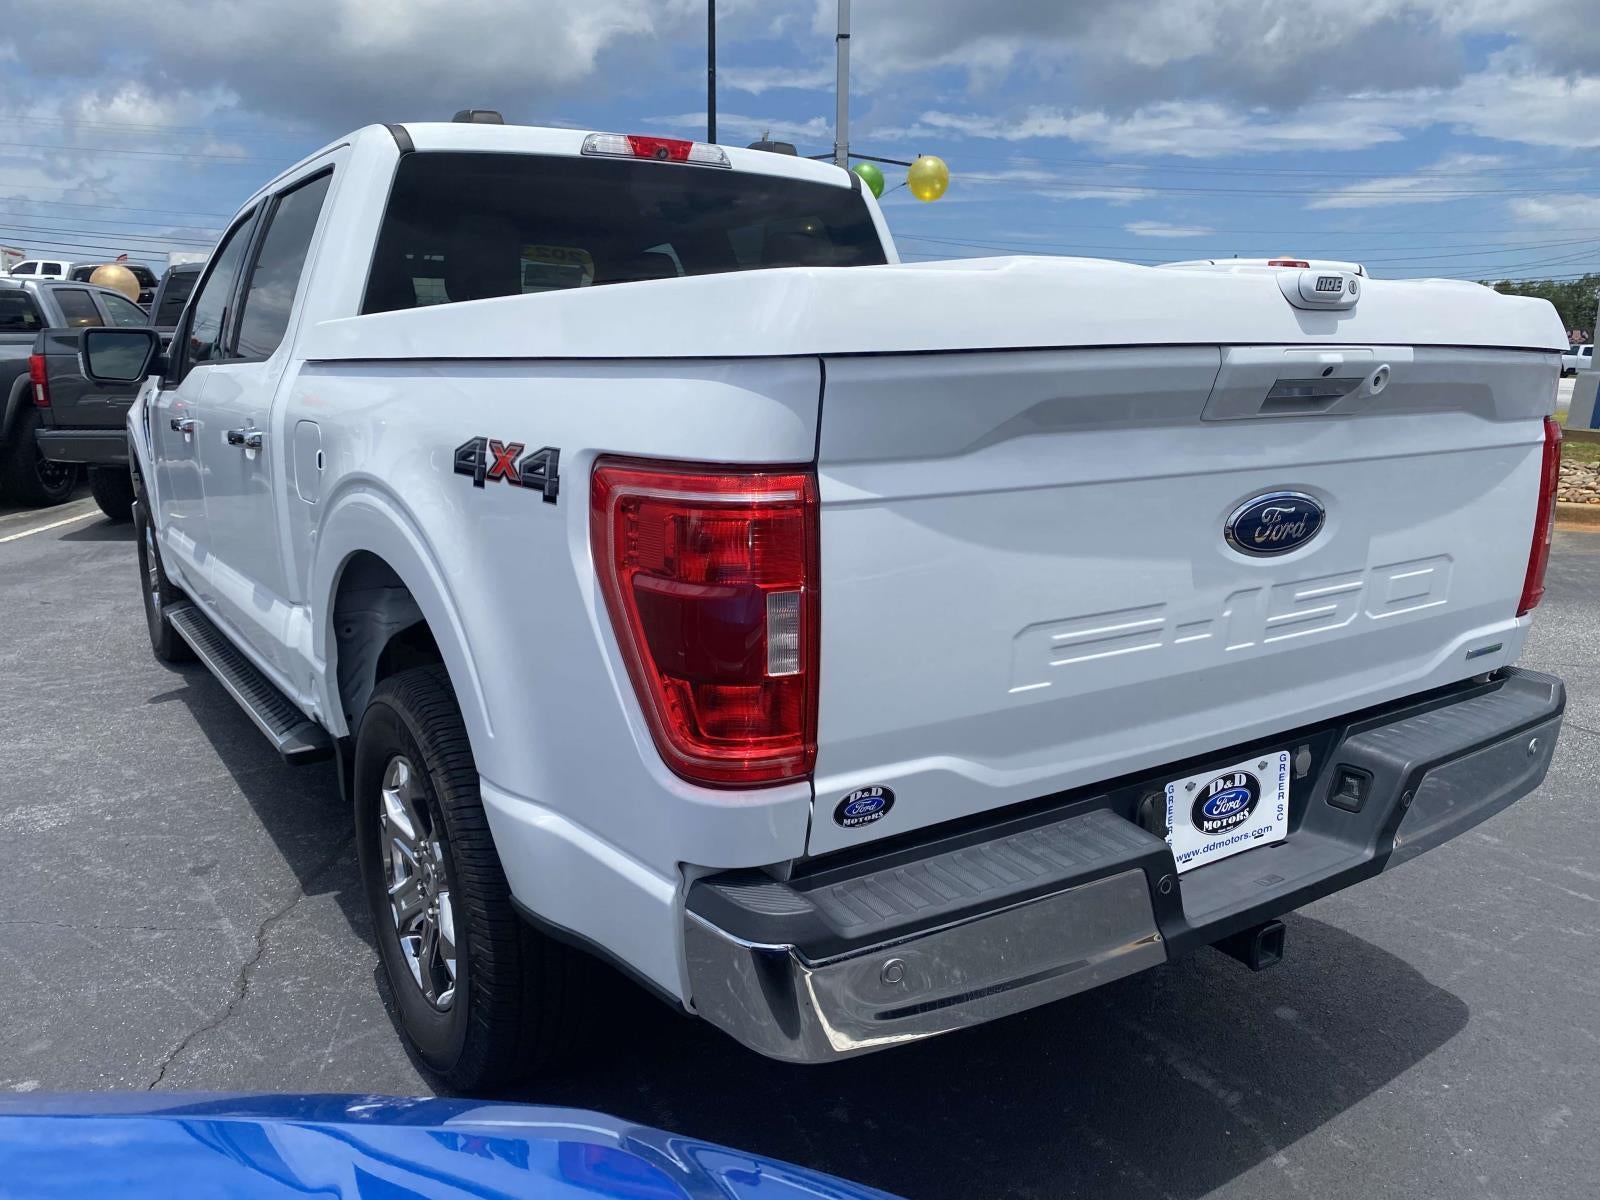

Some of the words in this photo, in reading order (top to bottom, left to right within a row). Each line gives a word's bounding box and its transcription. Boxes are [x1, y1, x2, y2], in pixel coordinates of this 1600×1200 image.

[1316, 277, 1342, 291] ARE
[1254, 506, 1308, 543] Ford
[1009, 553, 1454, 693] F-150
[1208, 773, 1247, 797] D&D
[1277, 753, 1287, 800] GREER
[849, 787, 883, 803] D&D
[1212, 793, 1242, 815] Ford
[852, 800, 878, 814] Ford
[1276, 804, 1284, 821] SC
[843, 810, 884, 828] MOTORS
[1203, 808, 1250, 831] MOTORS
[1176, 824, 1273, 862] www.ddmotors.com
